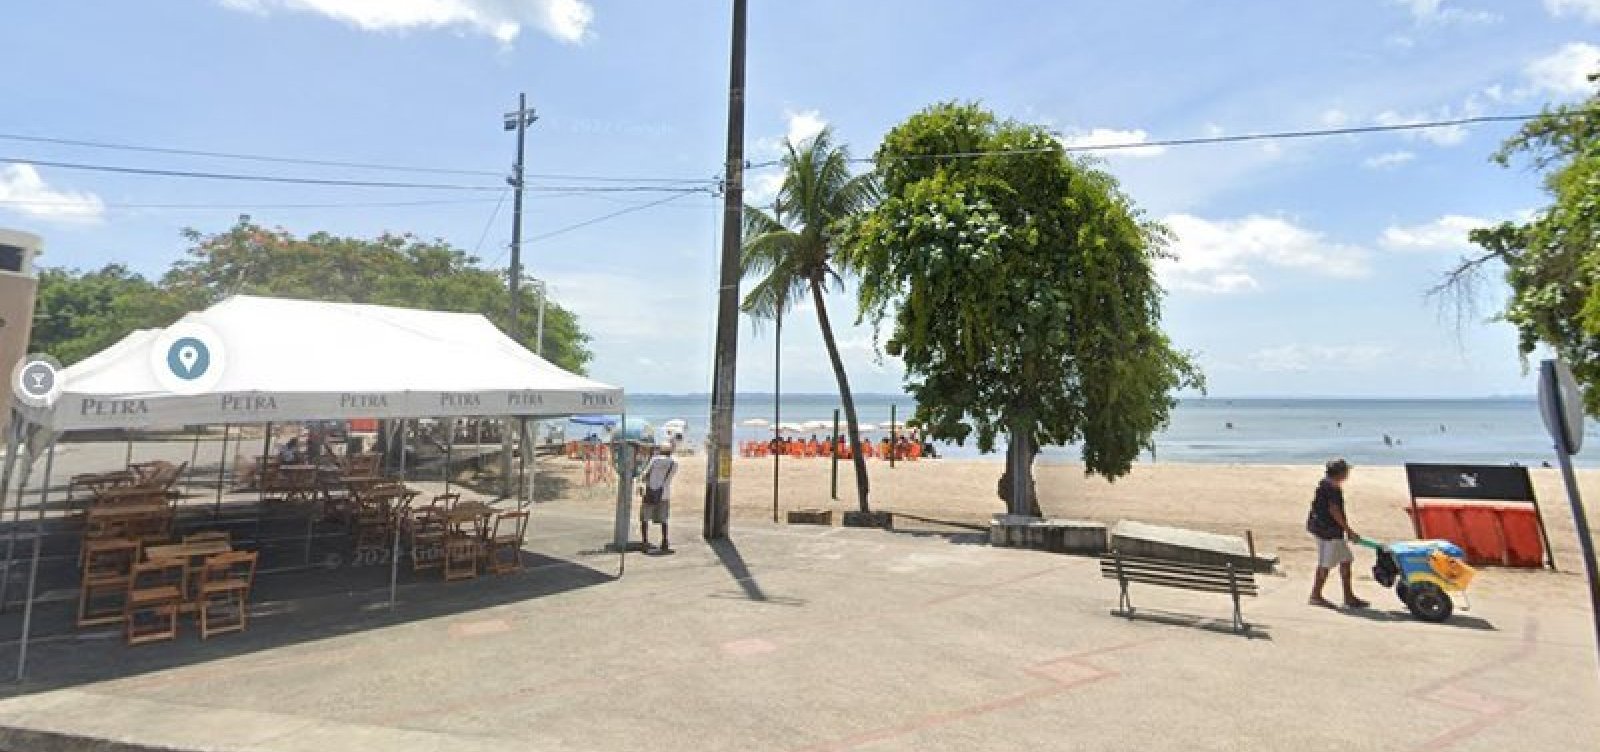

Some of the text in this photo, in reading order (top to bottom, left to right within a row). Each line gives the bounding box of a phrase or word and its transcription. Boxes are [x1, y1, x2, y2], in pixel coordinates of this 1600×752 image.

[81, 398, 148, 415] PETRA
[221, 394, 276, 410] PETRA
[341, 392, 388, 408] PETRA
